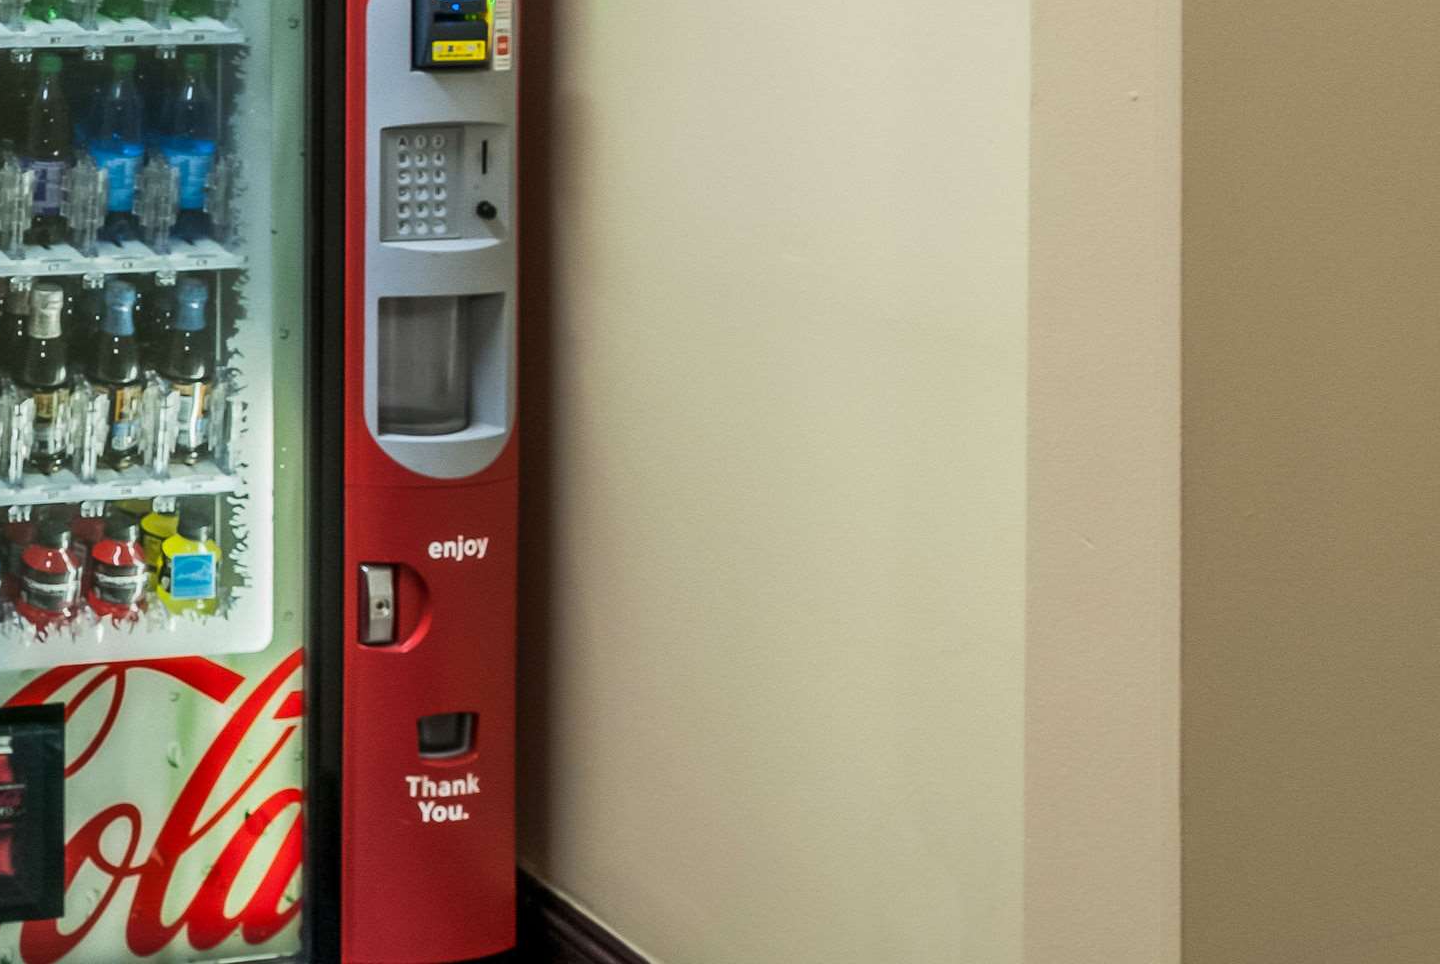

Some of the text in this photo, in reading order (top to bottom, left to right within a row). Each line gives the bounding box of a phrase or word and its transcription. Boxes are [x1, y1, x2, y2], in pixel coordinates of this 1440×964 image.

[428, 535, 489, 561] enjoy
[405, 773, 480, 798] Thank
[418, 801, 470, 823] You.
